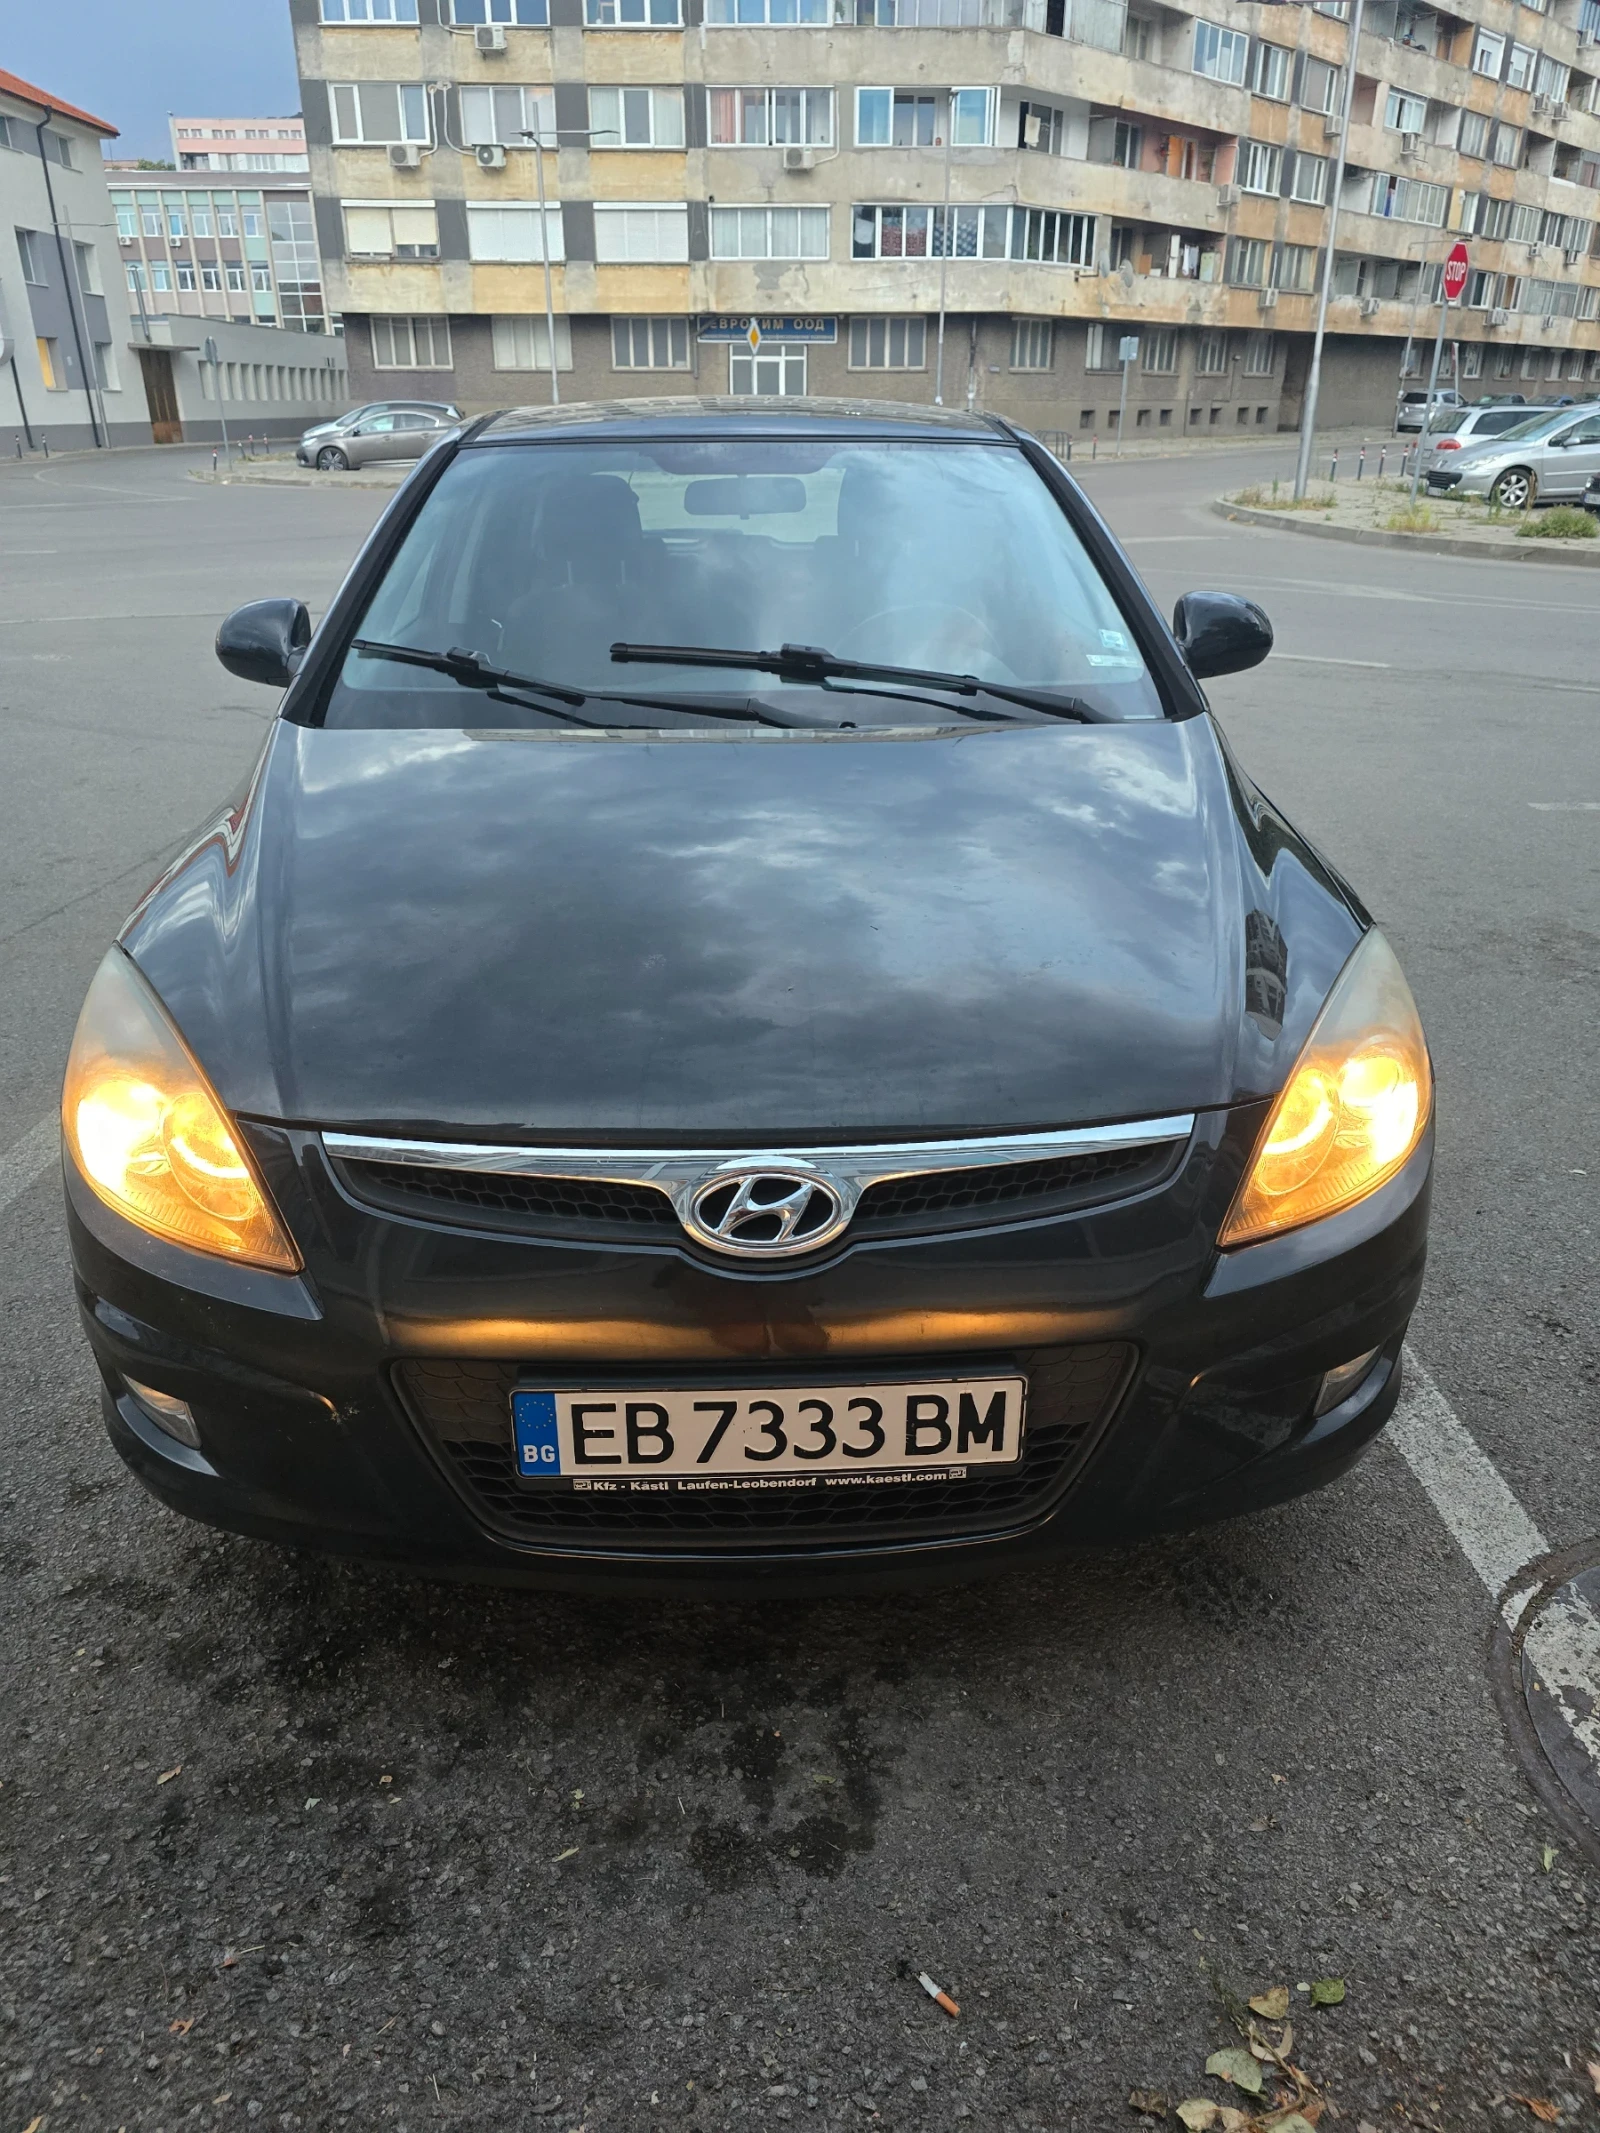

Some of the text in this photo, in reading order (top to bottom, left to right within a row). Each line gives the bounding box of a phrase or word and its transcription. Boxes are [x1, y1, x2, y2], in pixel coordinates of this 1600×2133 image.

[1446, 261, 1466, 281] STOP
[709, 318, 825, 332] ЕВРОИМ ООД
[570, 1390, 1007, 1465] EB 7333 BM
[522, 1444, 556, 1463] BG
[593, 1481, 617, 1491] Kfz
[630, 1480, 669, 1491] Kästl
[677, 1477, 817, 1491] Laufen-Leobendorf
[825, 1472, 947, 1486] www.kaestl.com
